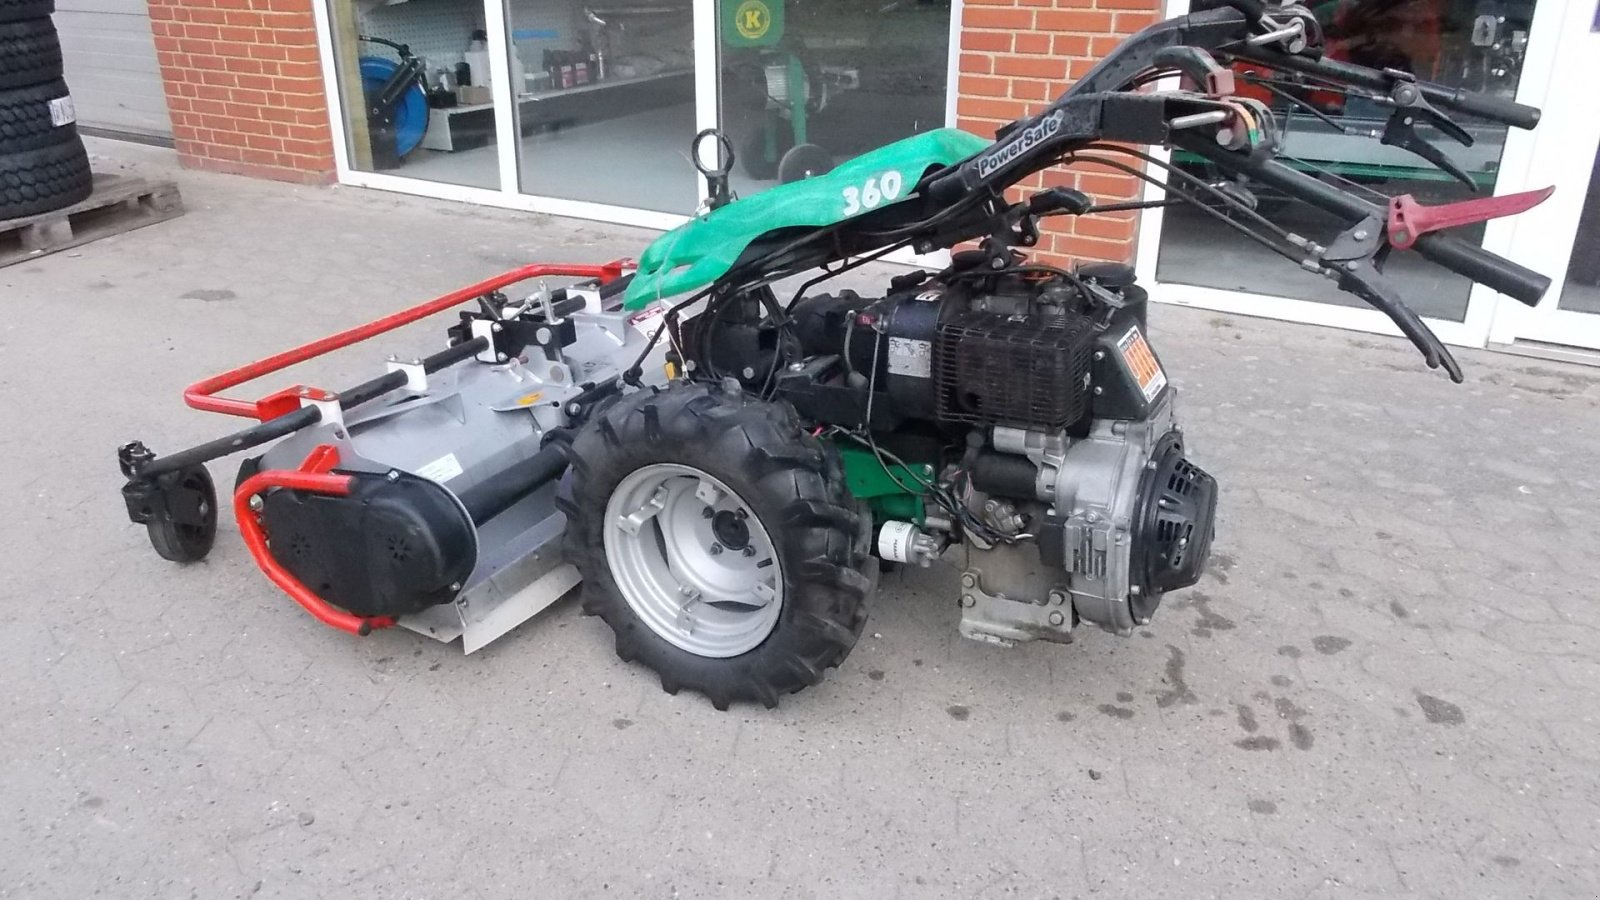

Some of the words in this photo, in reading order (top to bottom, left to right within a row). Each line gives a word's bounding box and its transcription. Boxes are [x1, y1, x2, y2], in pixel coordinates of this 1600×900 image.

[745, 10, 761, 29] K
[980, 117, 1059, 175] PowerSafe
[842, 171, 902, 217] 360
